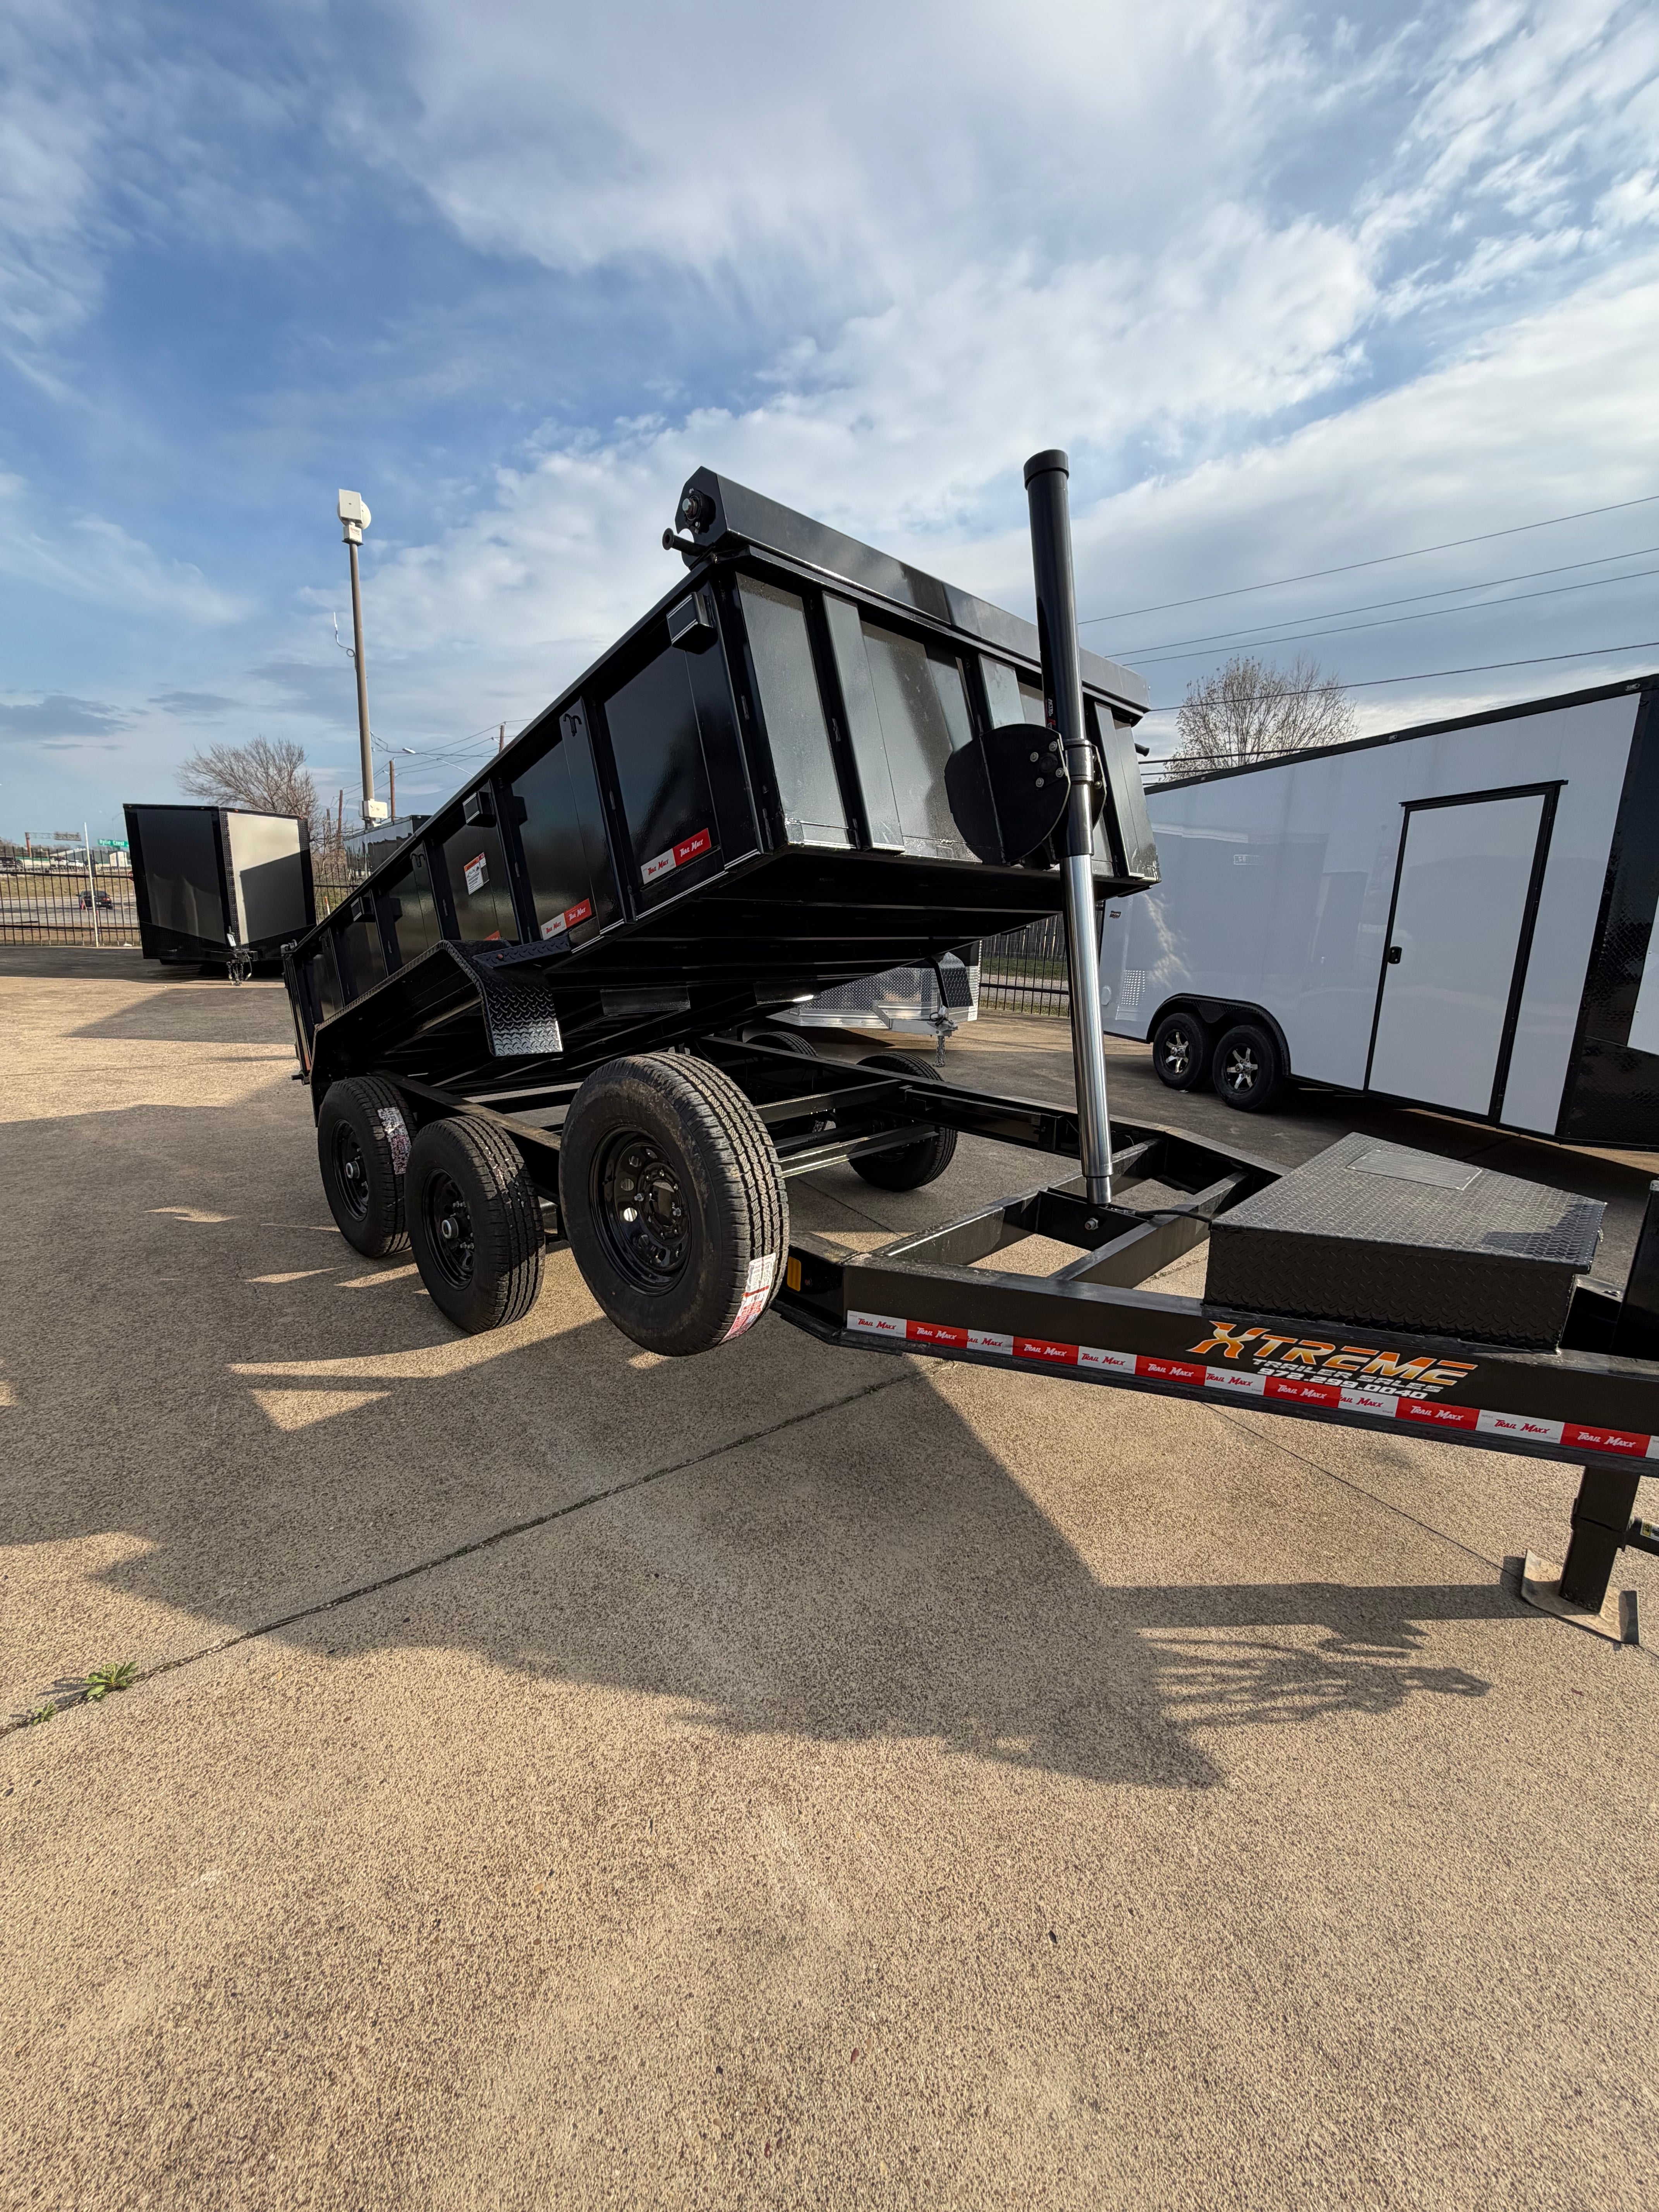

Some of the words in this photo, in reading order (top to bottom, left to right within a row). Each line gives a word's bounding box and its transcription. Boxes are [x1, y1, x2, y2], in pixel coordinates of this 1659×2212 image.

[1185, 1320, 1479, 1386] XTREME
[1252, 1358, 1353, 1380] TRAILER
[1357, 1375, 1444, 1393] SALES
[1257, 1367, 1428, 1400] 972.299.0040
